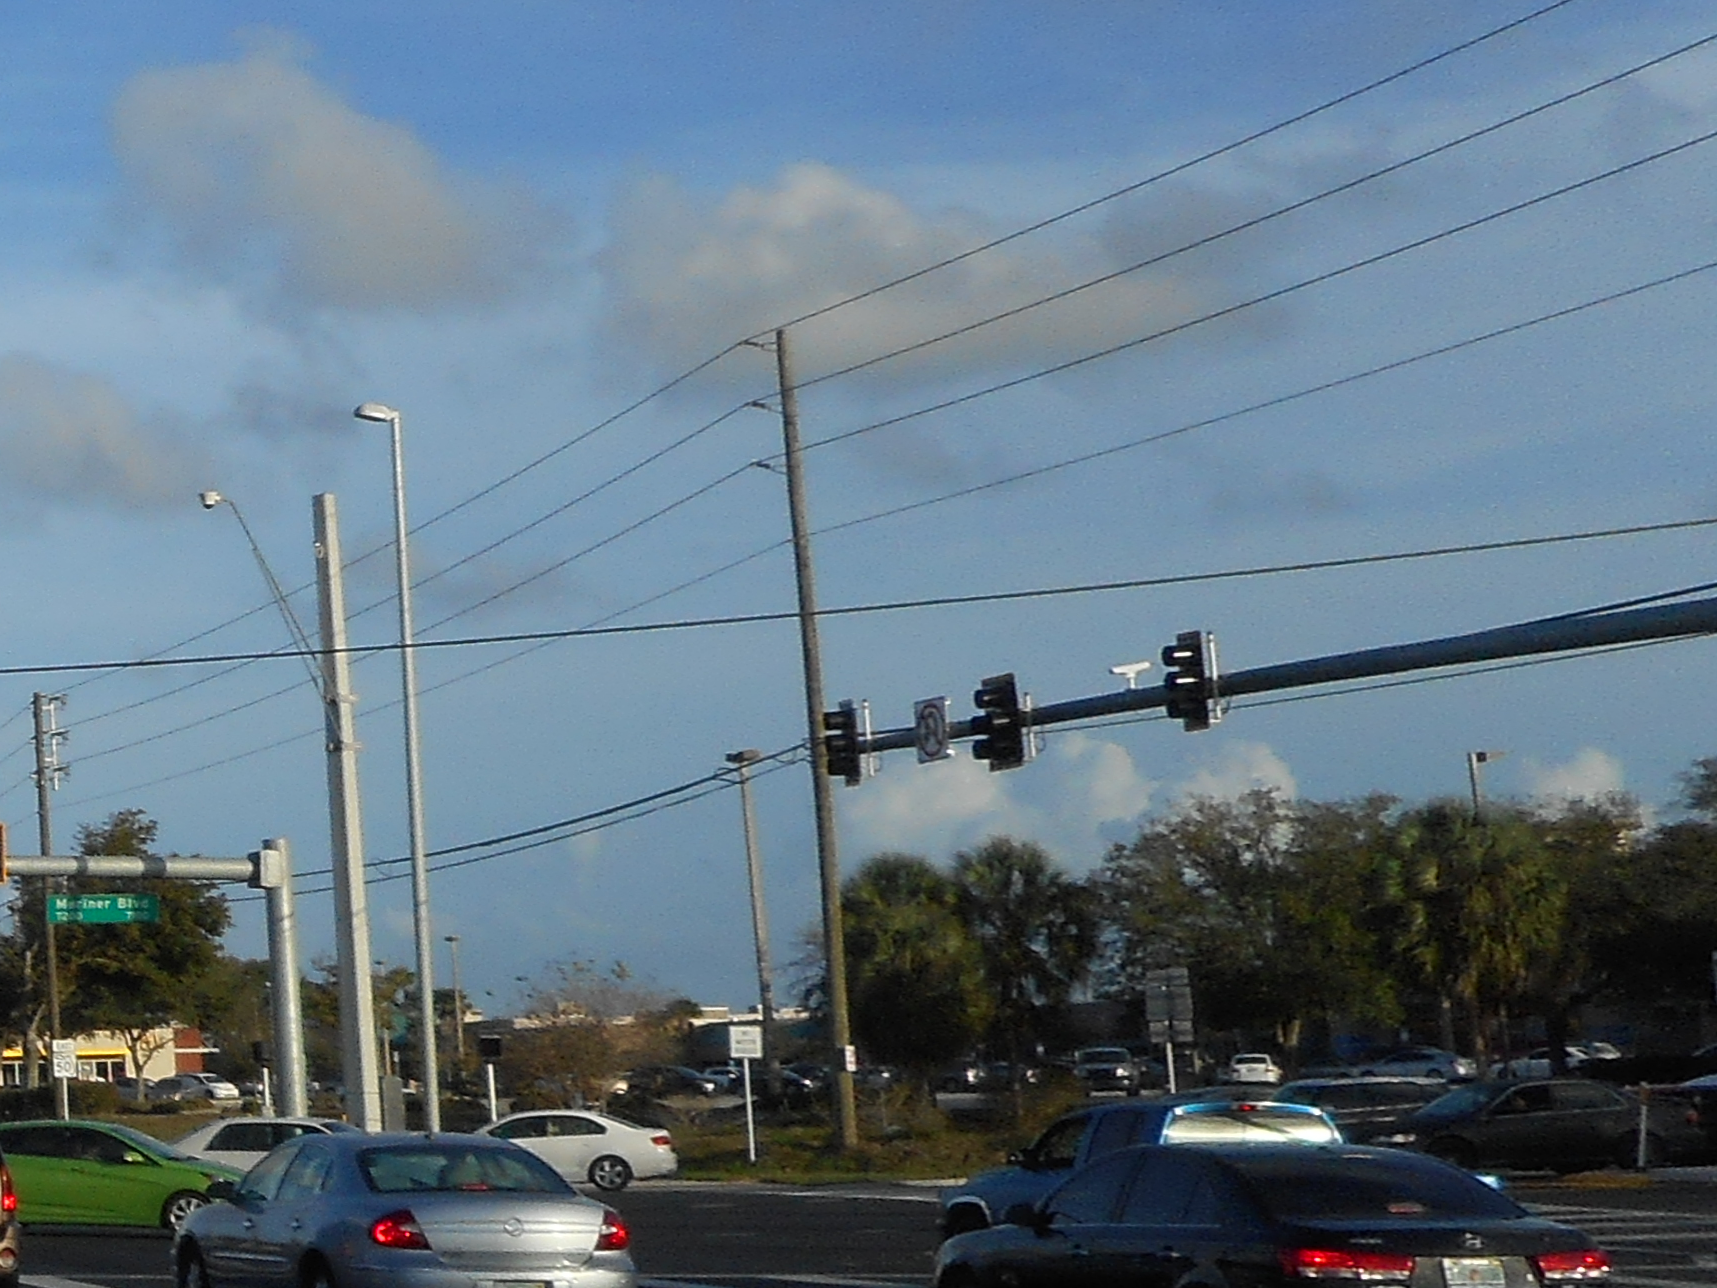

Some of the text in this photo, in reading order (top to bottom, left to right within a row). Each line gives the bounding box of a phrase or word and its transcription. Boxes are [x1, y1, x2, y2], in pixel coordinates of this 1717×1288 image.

[56, 897, 150, 910] Mariner Blvd
[55, 1060, 72, 1074] 50
